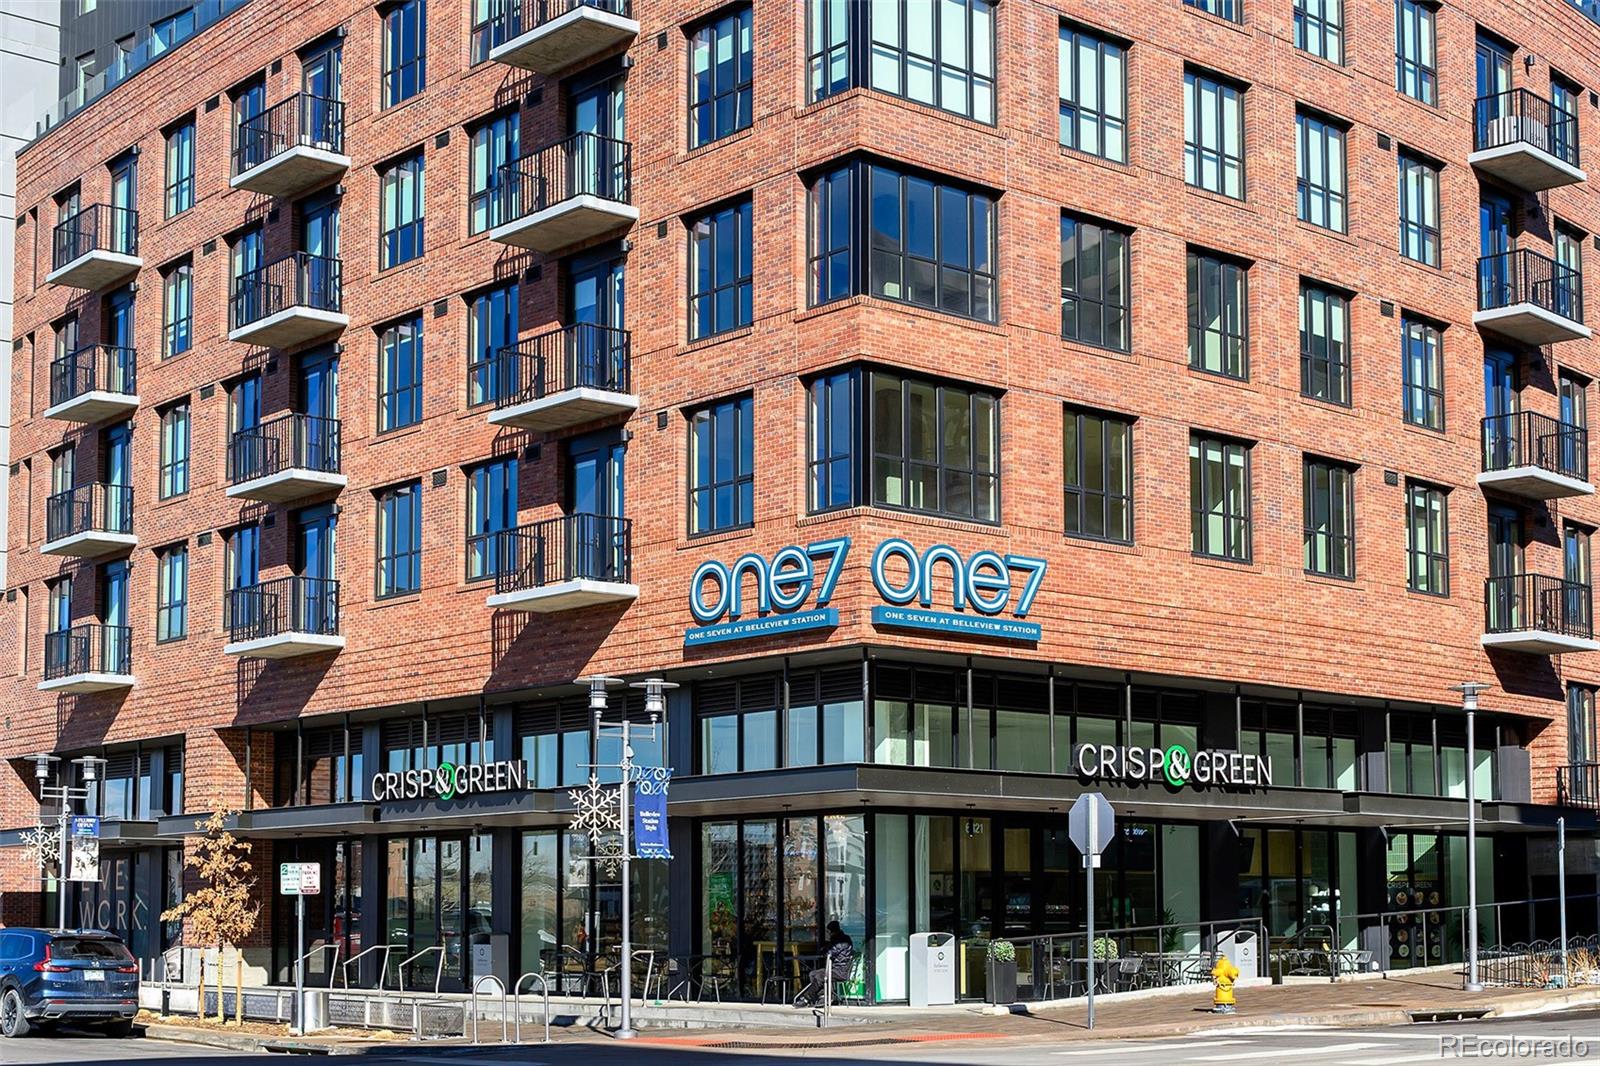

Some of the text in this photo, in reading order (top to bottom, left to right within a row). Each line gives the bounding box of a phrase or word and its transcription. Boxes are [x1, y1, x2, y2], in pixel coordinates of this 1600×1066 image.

[690, 536, 851, 622] one7
[871, 538, 1047, 616] one7
[688, 614, 826, 640] ONE SEVEN AT BELLEVIEW STATION
[885, 612, 1038, 635] ONE SEVEN AT BELLEVIEW STATION
